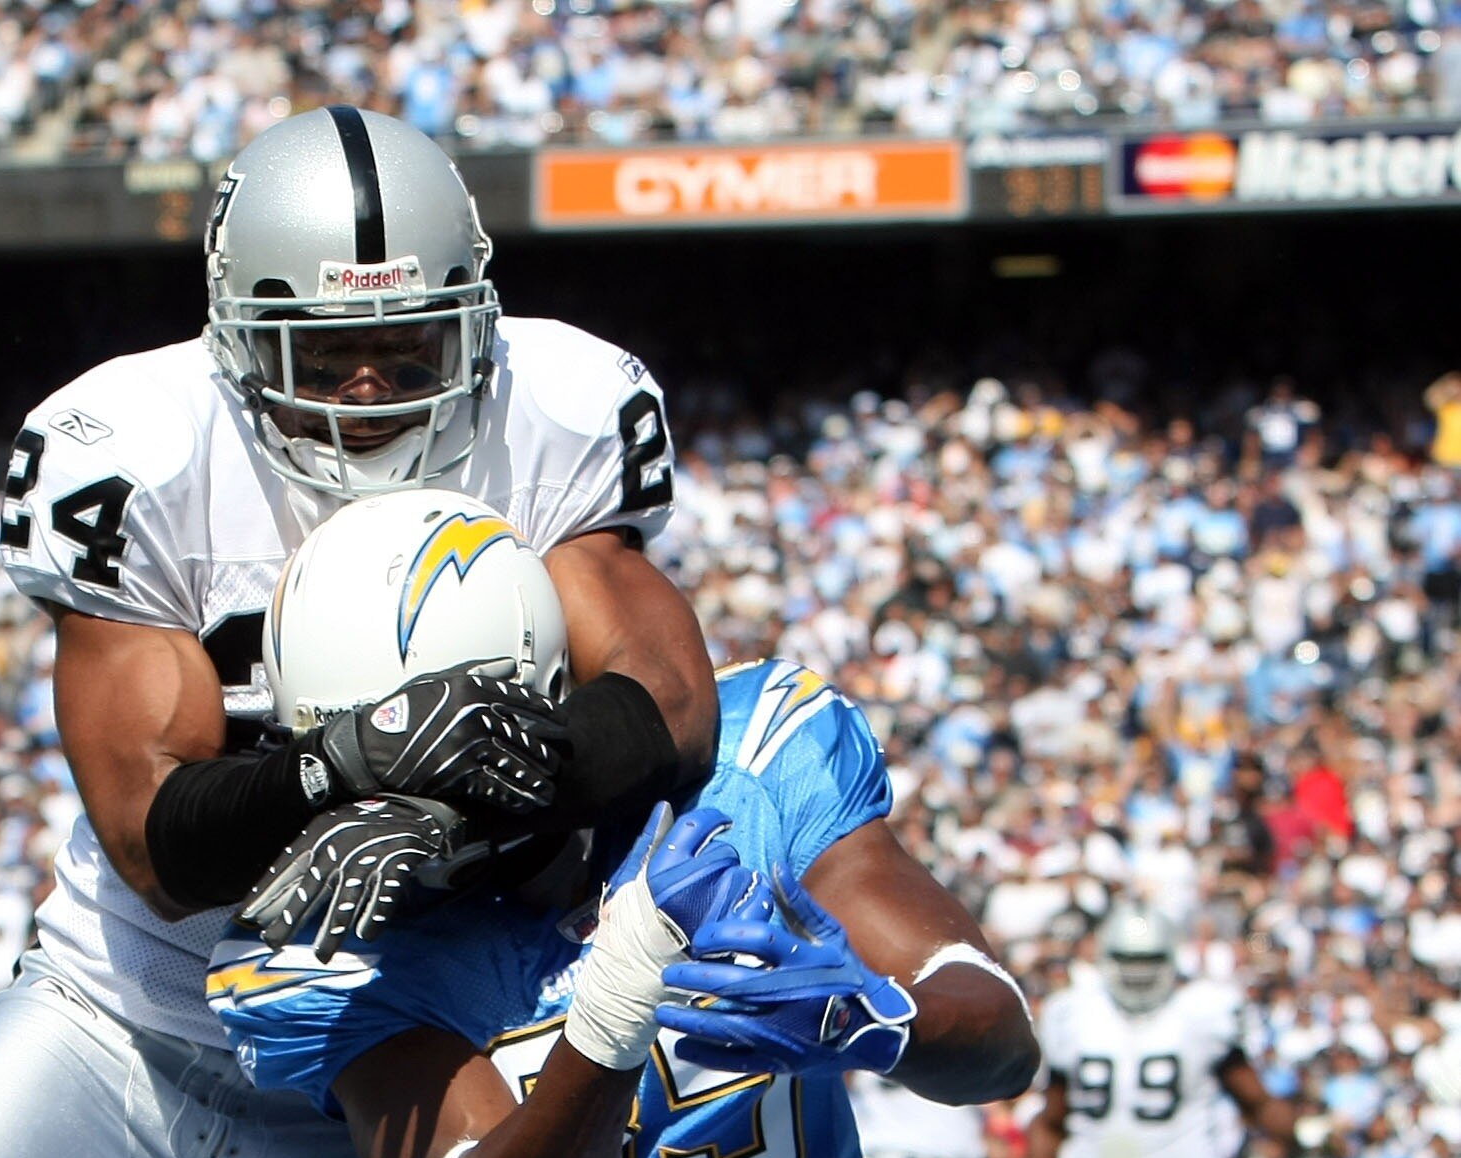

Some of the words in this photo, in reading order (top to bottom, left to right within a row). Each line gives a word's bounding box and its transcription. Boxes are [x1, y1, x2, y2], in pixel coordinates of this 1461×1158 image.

[613, 150, 877, 214] CYMER
[1239, 130, 1461, 198] Master
[342, 268, 404, 289] Riddell
[0, 428, 135, 589] 24
[1067, 1053, 1182, 1121] 99
